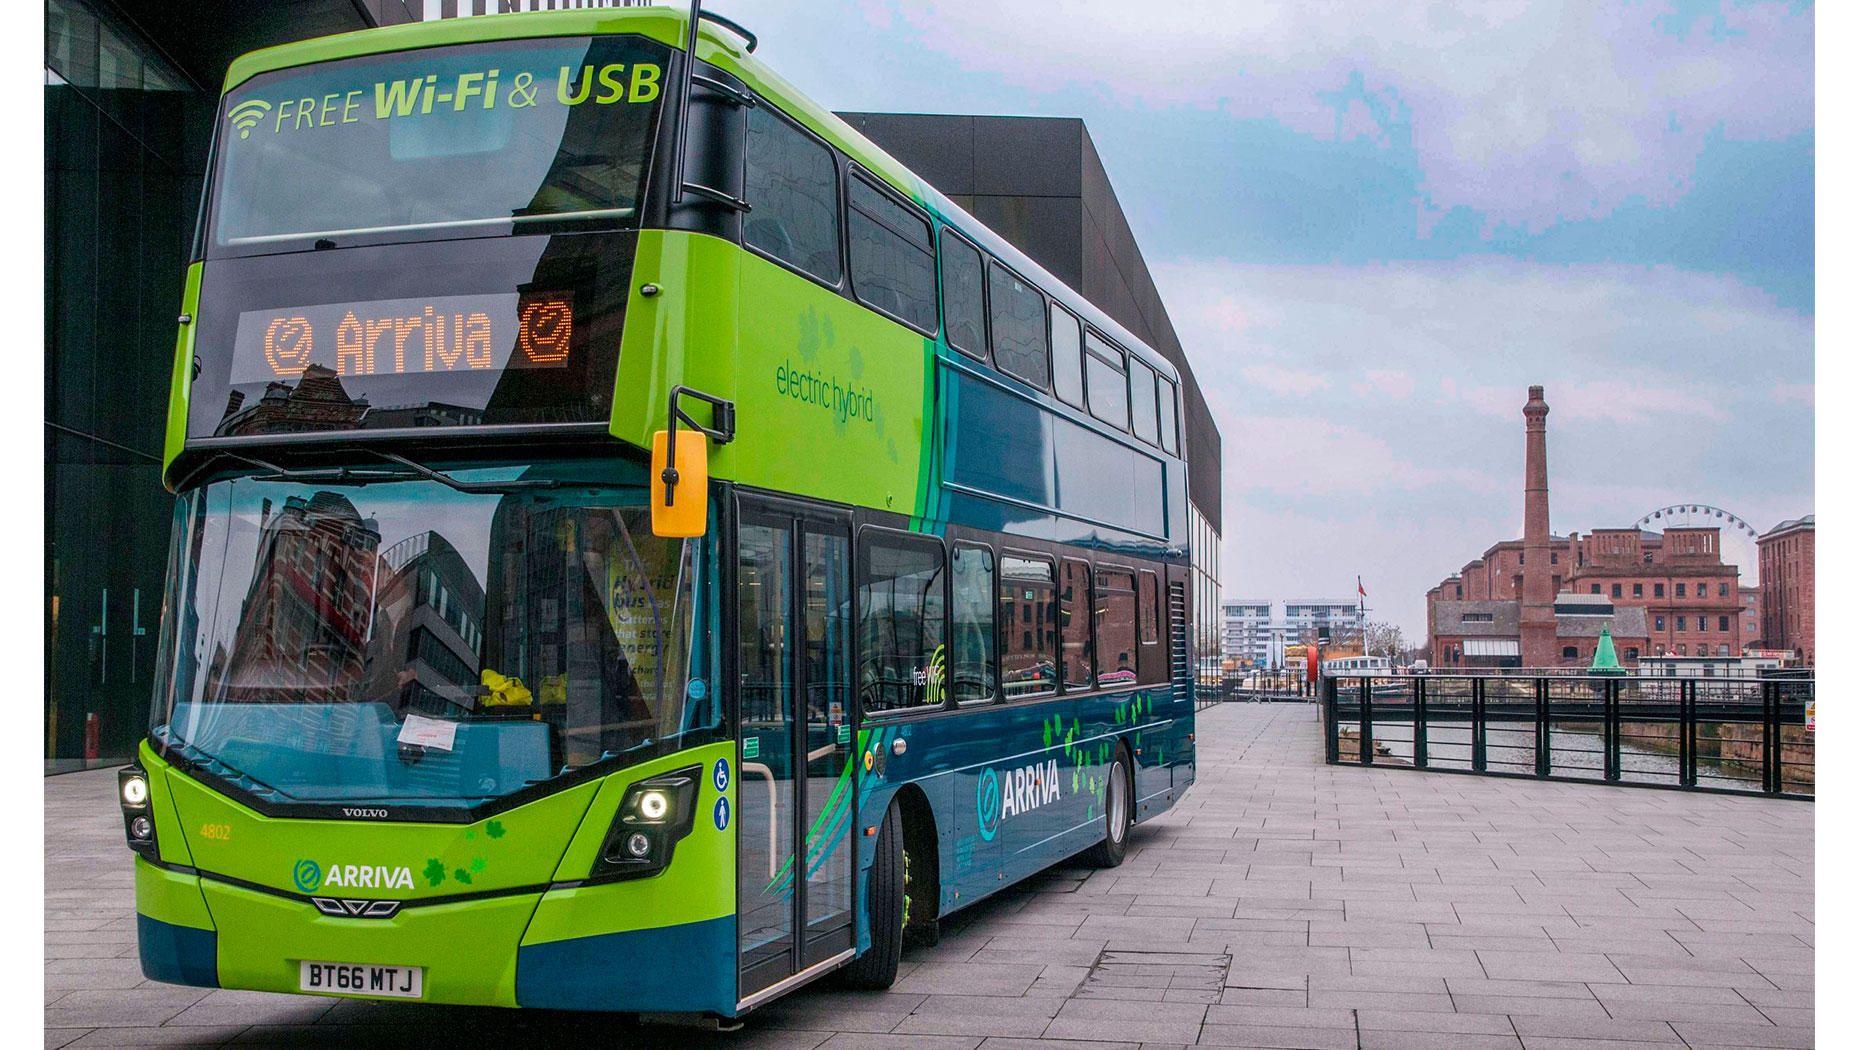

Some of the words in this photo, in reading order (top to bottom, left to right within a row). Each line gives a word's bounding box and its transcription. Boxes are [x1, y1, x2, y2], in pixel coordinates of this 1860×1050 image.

[275, 90, 363, 133] FREE
[375, 69, 500, 119] Wi-Fi
[507, 72, 538, 109] &
[556, 63, 661, 107] USB
[336, 306, 492, 375] Arriva
[776, 359, 830, 408] electric
[832, 376, 873, 423] hybrid
[913, 665, 926, 686] free
[1001, 758, 1061, 820] ARRIVA
[342, 808, 389, 819] VOLVO
[200, 823, 231, 841] 4802
[324, 863, 415, 890] ARRIVA
[309, 963, 364, 990] BT66
[370, 967, 413, 993] MTJ
